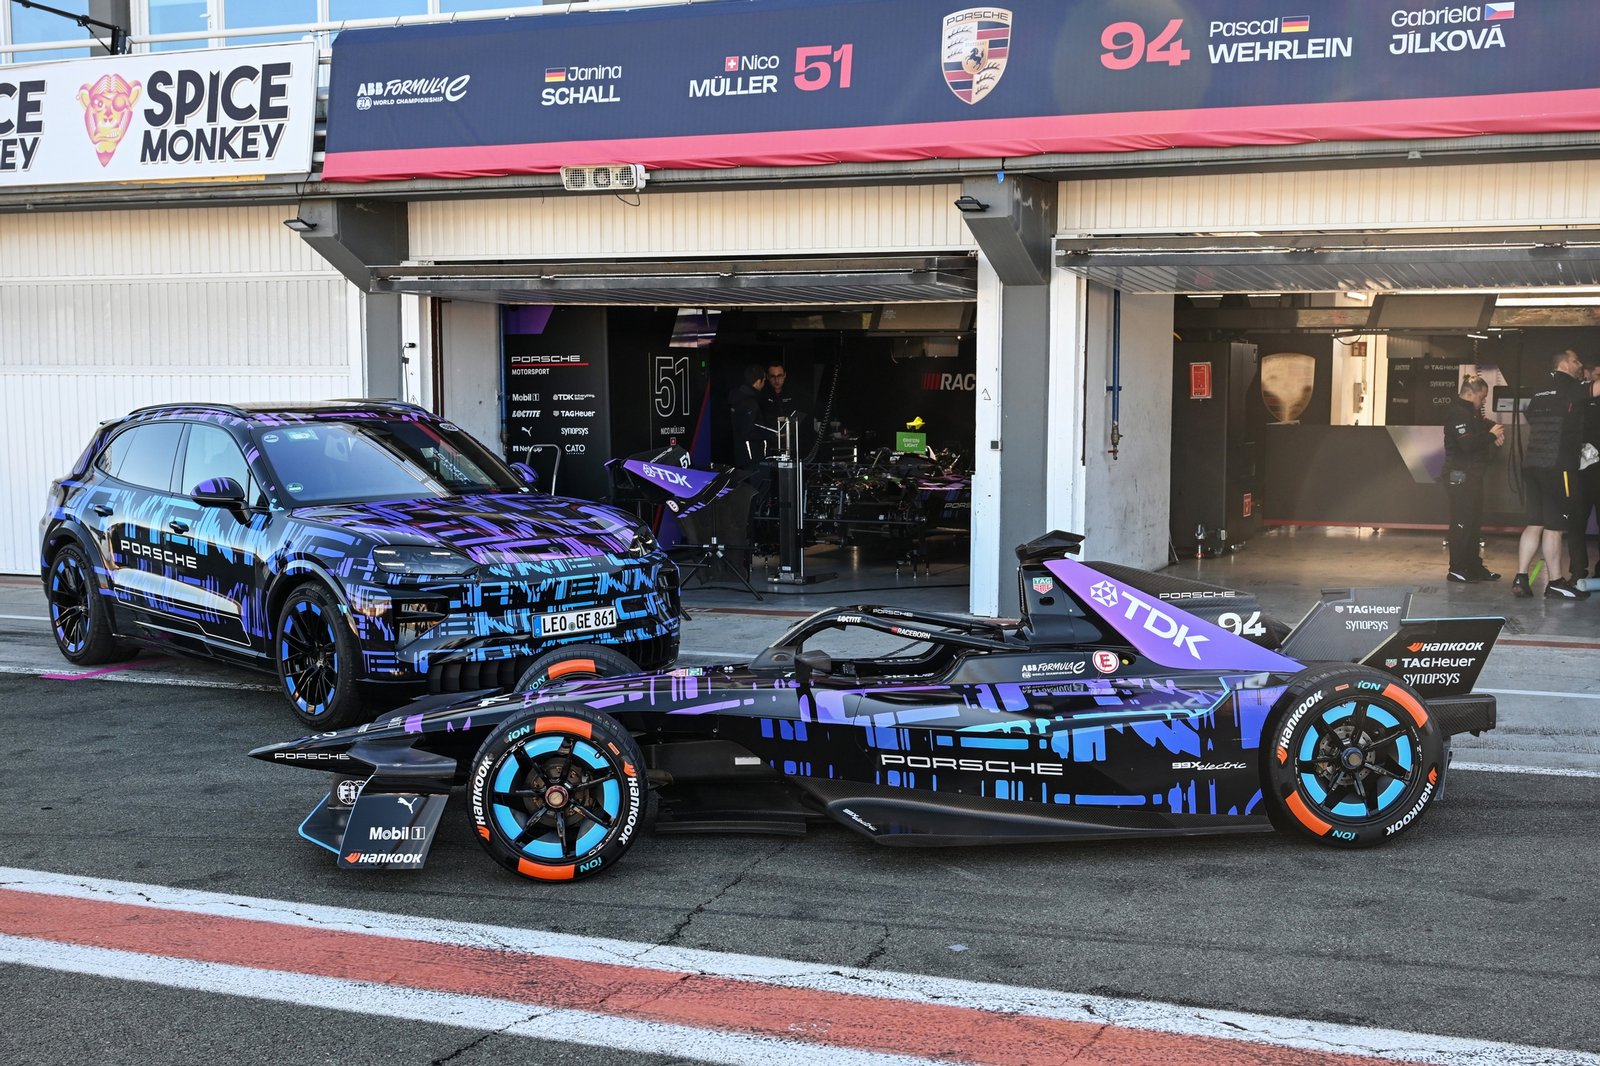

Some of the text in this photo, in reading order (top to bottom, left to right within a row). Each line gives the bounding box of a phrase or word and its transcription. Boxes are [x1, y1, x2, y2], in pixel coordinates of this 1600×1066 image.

[946, 11, 1009, 26] PORSCHE
[1391, 5, 1481, 29] Gabriela
[1209, 18, 1278, 37] Pascal
[1100, 19, 1191, 71] 94
[1389, 25, 1507, 56] JÍLKOVÁ
[1208, 37, 1353, 64] WEHRLEIN
[741, 55, 780, 71] Nico
[794, 43, 853, 92] 51
[568, 65, 622, 82] Janina
[144, 62, 291, 127] SPICE
[357, 82, 384, 96] ABB
[384, 77, 449, 96] FORMULA
[541, 85, 621, 106] SCHALL
[689, 75, 778, 98] MÜLLER
[396, 97, 444, 105] CHAMPIONSHIP
[140, 123, 285, 163] MONKEY
[511, 354, 581, 363] PORSCHE
[654, 356, 690, 418] 51
[512, 393, 532, 402] Mobil
[557, 393, 573, 401] TDK
[512, 410, 541, 418] LOCTITE
[565, 444, 586, 452] CATO
[651, 466, 693, 489] TDK
[120, 540, 197, 569] PORSCHE
[1159, 591, 1236, 599] PORSCHE
[543, 615, 567, 633] LEO
[576, 612, 592, 629] GE
[595, 609, 616, 627] 861
[872, 608, 914, 617] PORSCHE
[897, 627, 931, 640] RACEBORN
[1118, 591, 1211, 661] TDK
[1218, 611, 1267, 637] 94
[1021, 664, 1037, 672] ABB
[1037, 661, 1073, 672] FORMULA
[1099, 653, 1112, 668] E
[274, 752, 350, 760] PORSCHE
[881, 754, 1063, 776] PORSCHE
[369, 826, 410, 840] Mobil
